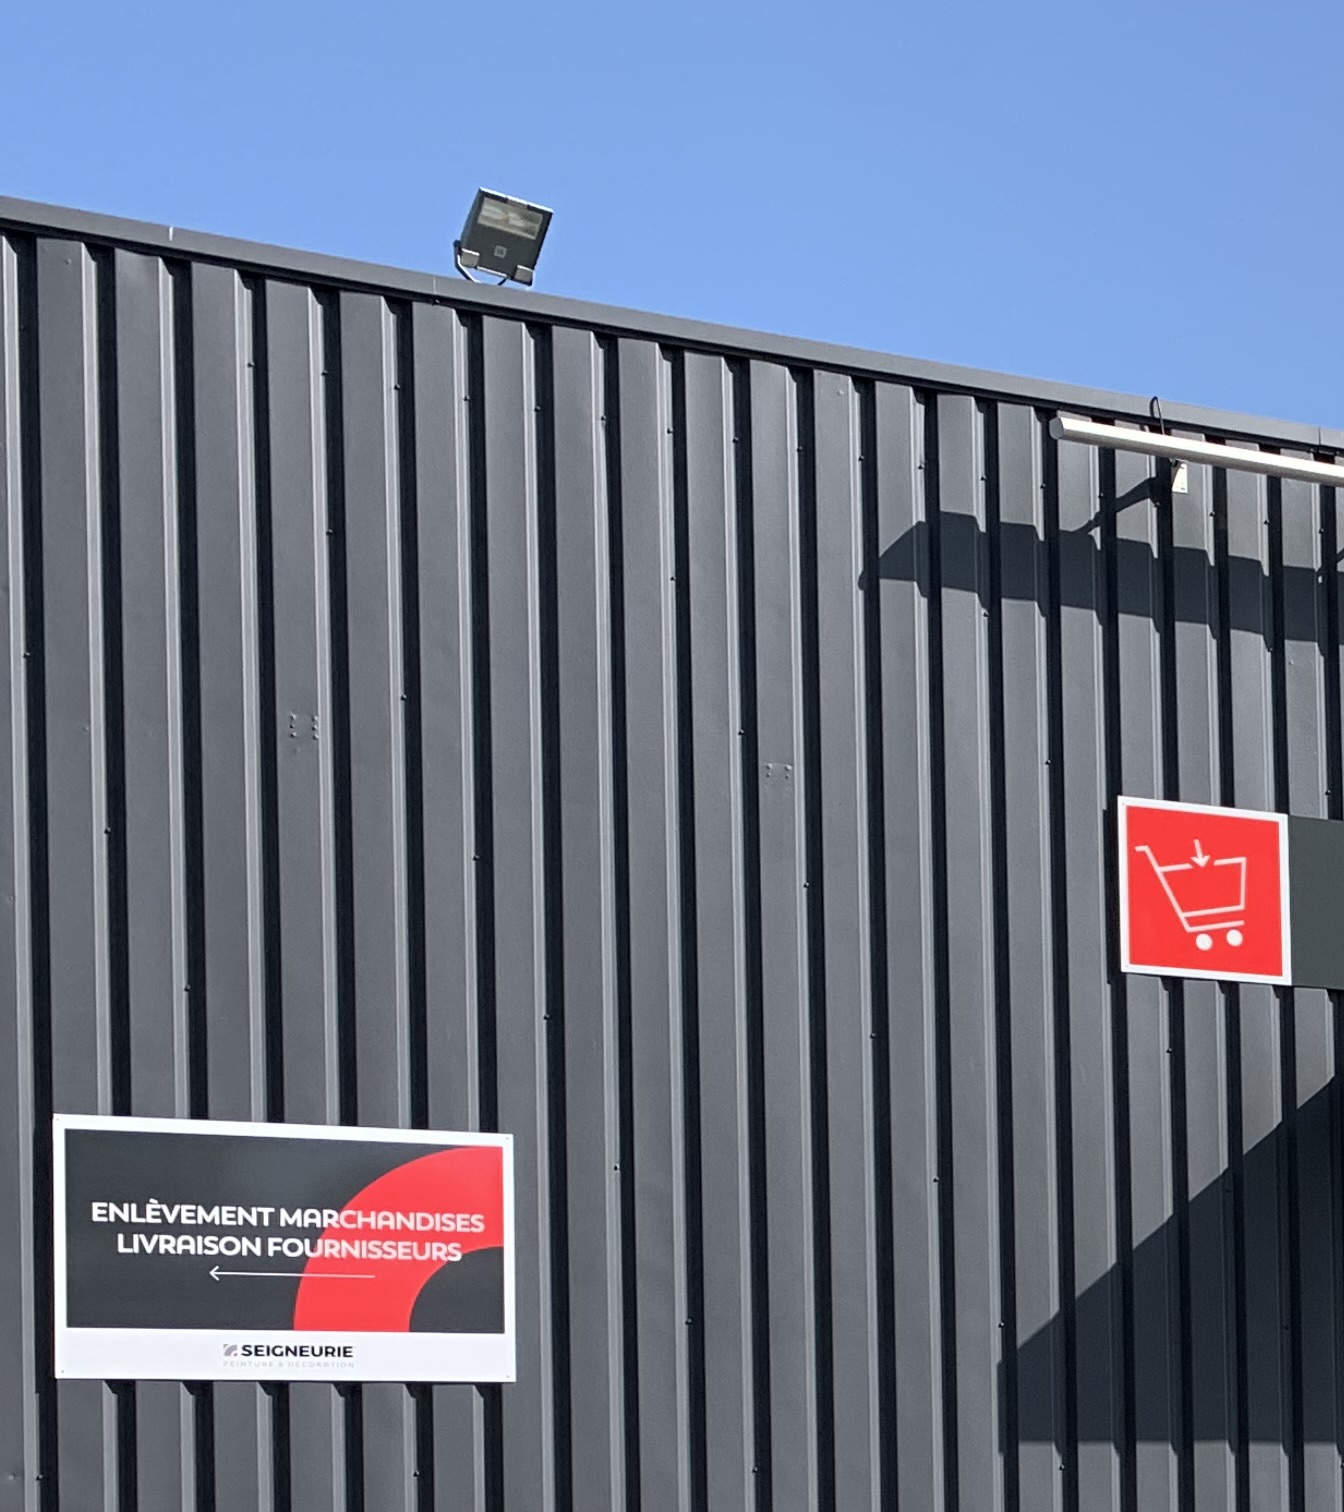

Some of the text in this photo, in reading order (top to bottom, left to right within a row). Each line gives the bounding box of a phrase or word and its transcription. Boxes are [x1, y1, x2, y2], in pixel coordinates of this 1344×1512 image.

[91, 1199, 486, 1233] ENLÈVEMENT MARCHANDISES
[117, 1234, 463, 1263] LIVRAISON FOURNISSEURS
[240, 1344, 354, 1358] SEIGNEURIE
[223, 1360, 273, 1368] PEINTURE
